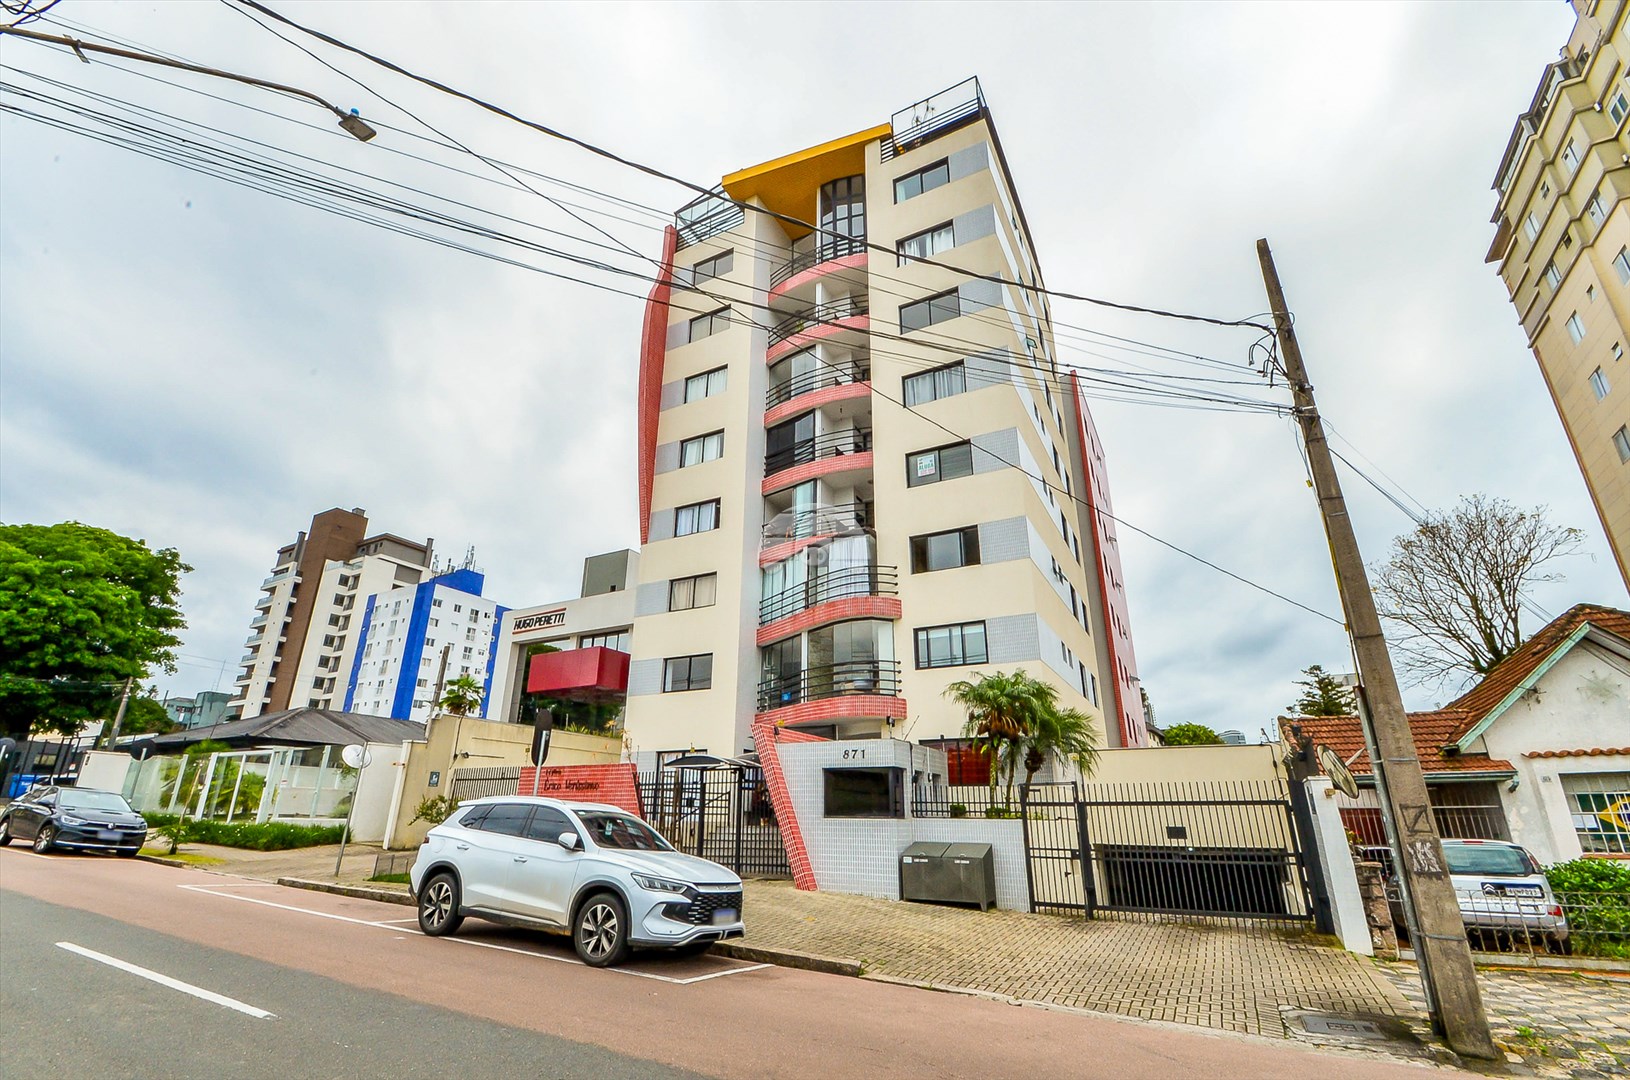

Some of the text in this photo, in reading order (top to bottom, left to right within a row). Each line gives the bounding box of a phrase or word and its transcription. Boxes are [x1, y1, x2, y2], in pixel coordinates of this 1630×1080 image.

[513, 612, 565, 630] HUGO PERETTI
[843, 749, 865, 759] 871
